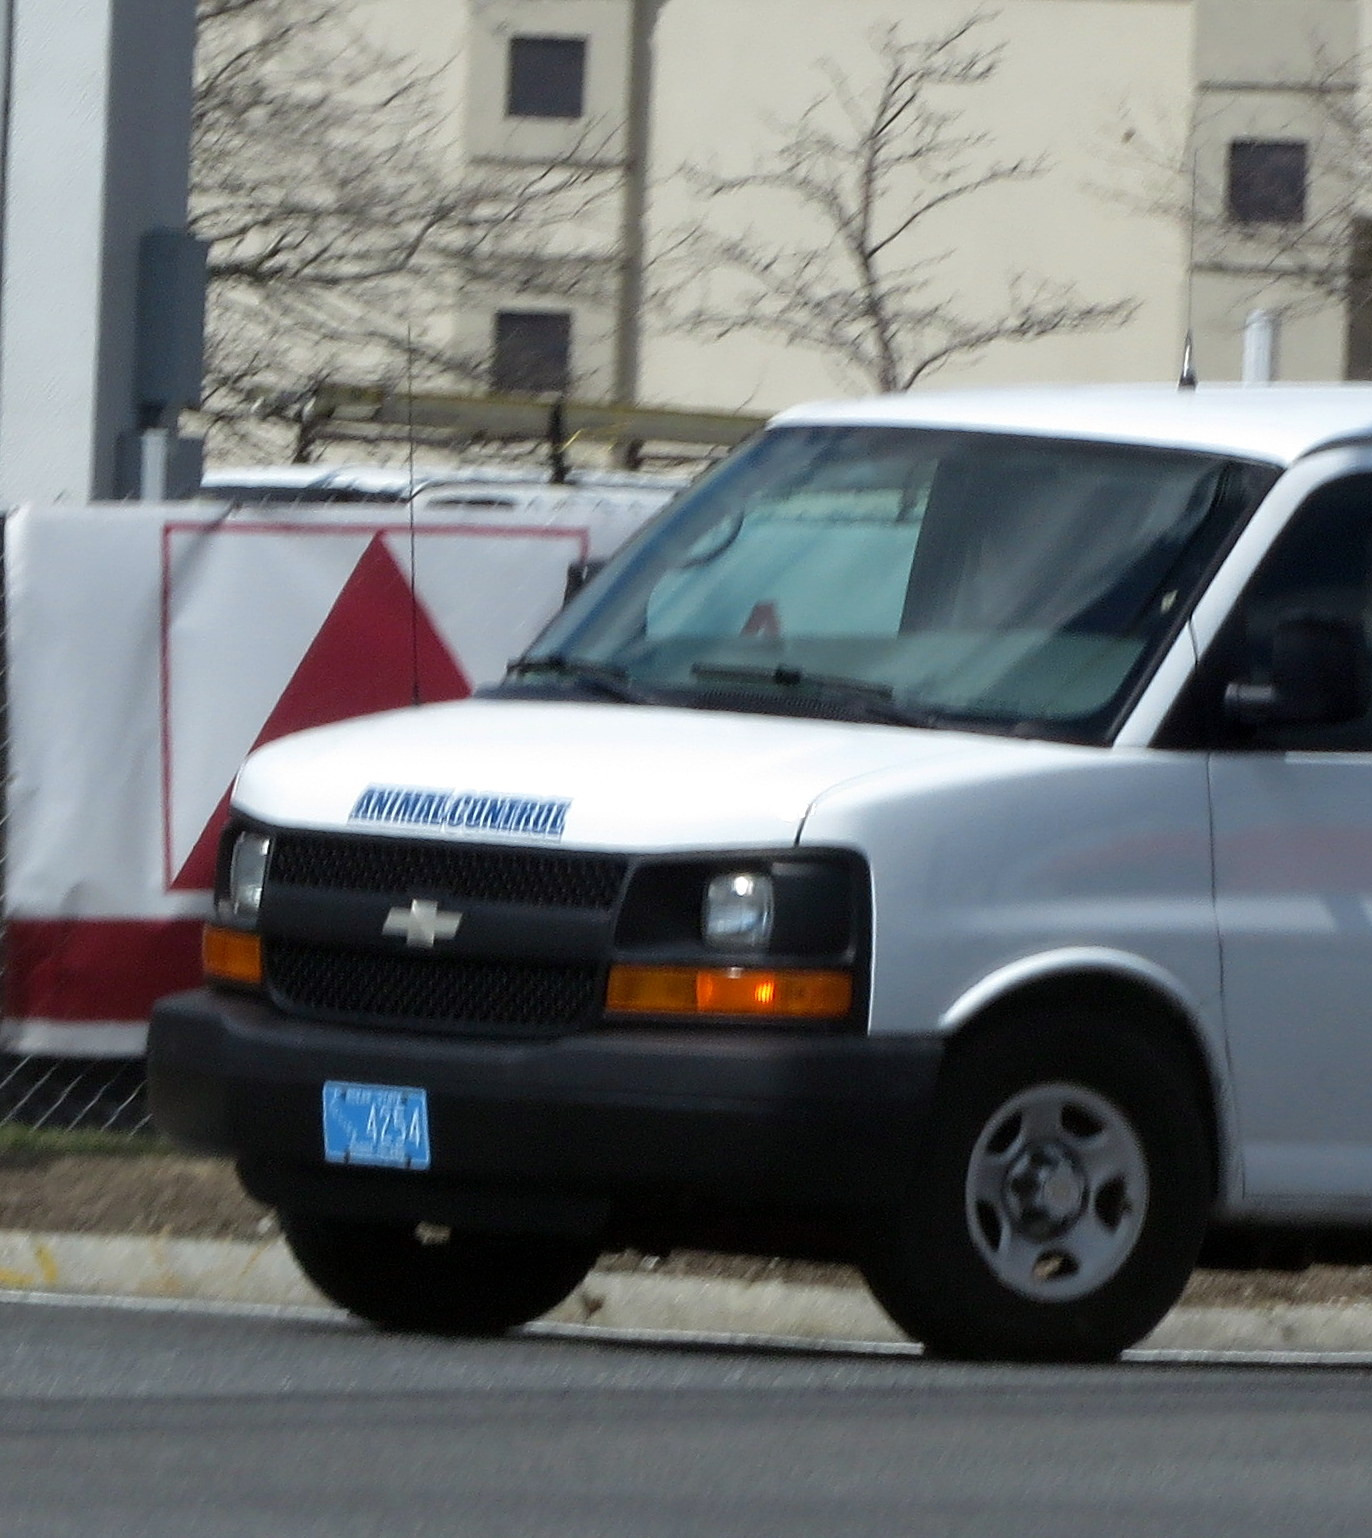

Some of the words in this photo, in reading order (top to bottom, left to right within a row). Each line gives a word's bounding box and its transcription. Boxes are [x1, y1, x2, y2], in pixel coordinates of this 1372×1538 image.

[350, 785, 453, 827] ANIMAL
[447, 793, 572, 837] CONTROL
[366, 1103, 421, 1149] 4254
